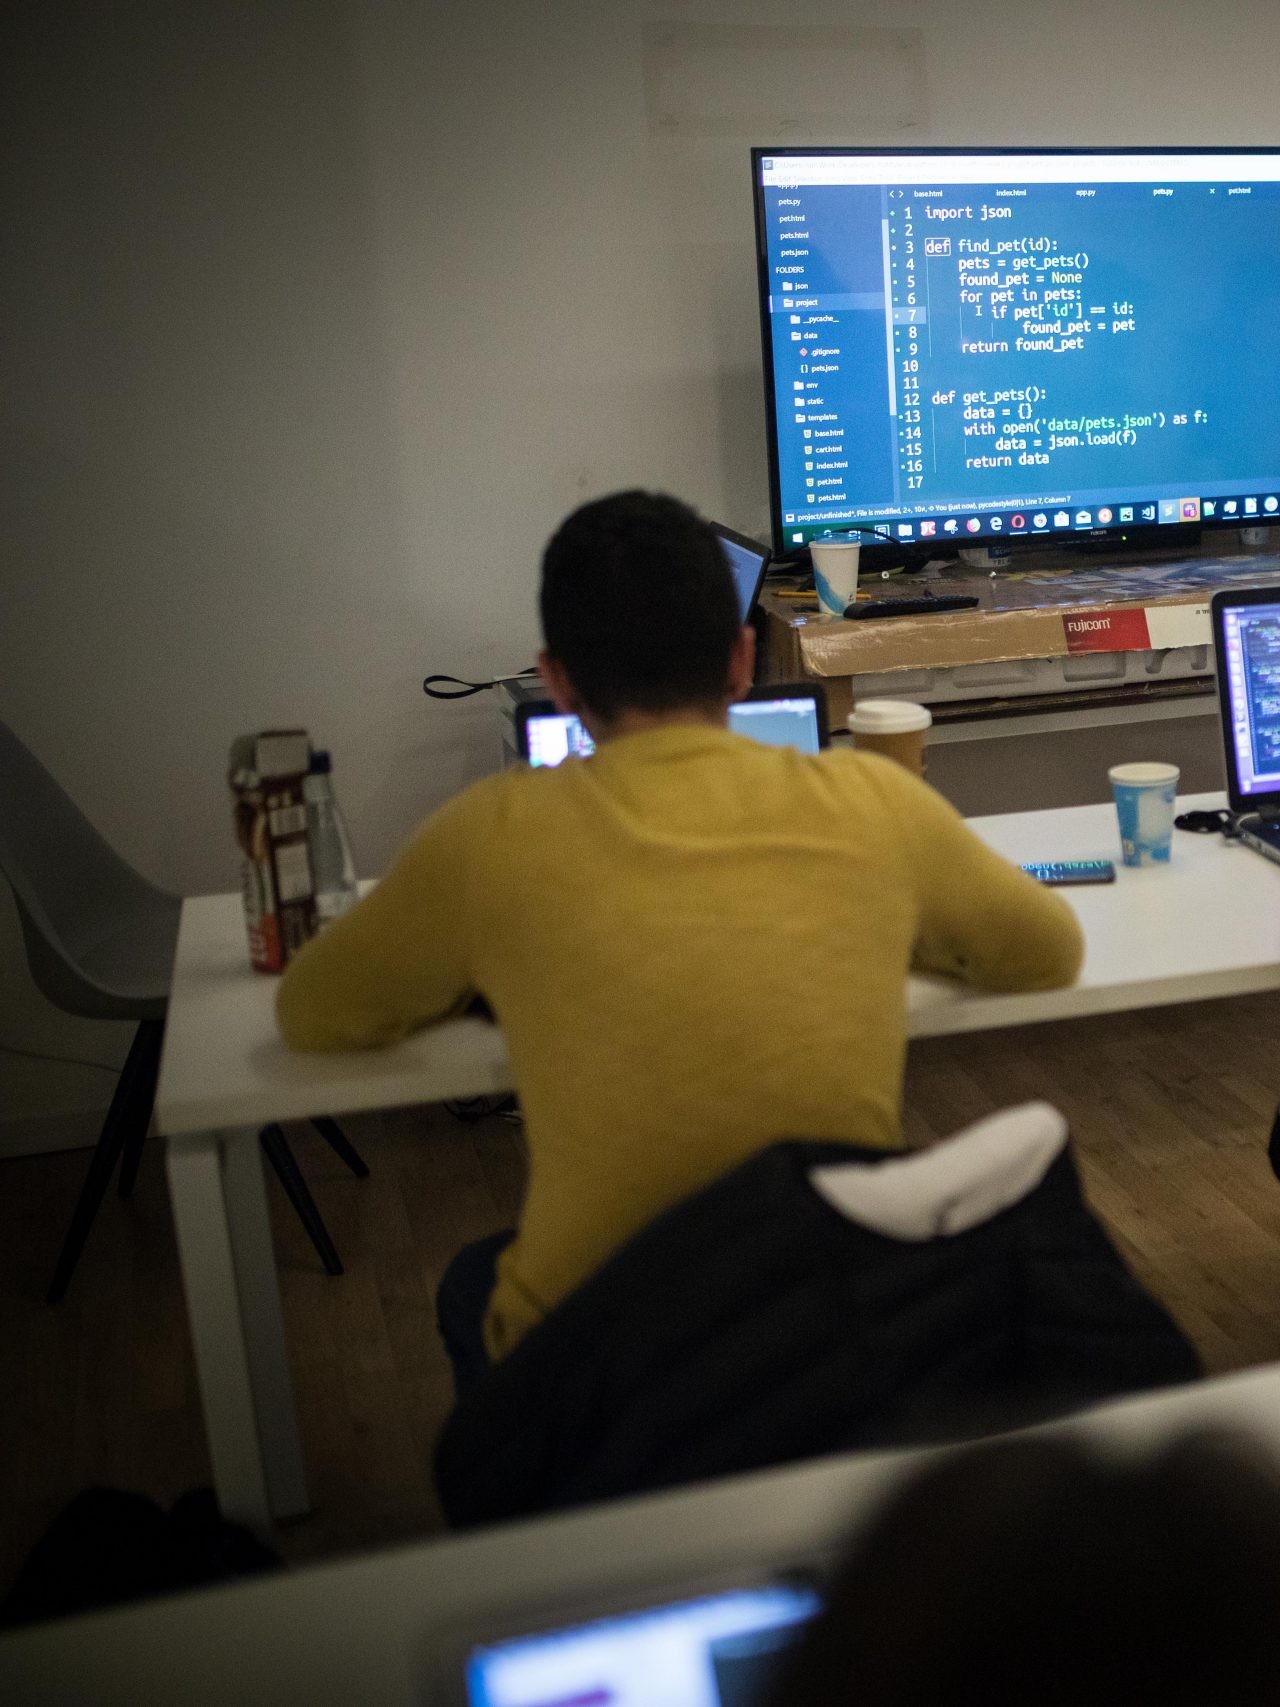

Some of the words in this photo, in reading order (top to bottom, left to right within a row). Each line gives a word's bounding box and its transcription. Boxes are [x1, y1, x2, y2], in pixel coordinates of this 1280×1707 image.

[914, 190, 943, 198] base.html
[996, 188, 1026, 197] index.html
[1076, 189, 1096, 197] app.py
[1153, 188, 1173, 197] pets.py
[1228, 187, 1251, 195] pet.html
[778, 199, 800, 207] pets.py
[779, 214, 806, 223] pet.html
[904, 207, 913, 220] 1
[925, 206, 973, 221] import
[980, 205, 1012, 220] json
[780, 231, 809, 240] pets.html
[905, 224, 913, 237] 2
[905, 241, 914, 254] 3
[926, 240, 950, 253] def
[958, 238, 1058, 254] find_pet(id):
[781, 248, 809, 257] pets.json
[906, 259, 915, 271] 4
[959, 256, 990, 272] pets
[1013, 252, 1089, 269] get_pets()
[775, 266, 804, 274] FOLDERS
[907, 276, 915, 288] 5
[959, 272, 1029, 288] found_pet
[1052, 271, 1082, 284] None
[795, 282, 809, 291] json
[908, 293, 916, 305] 6
[960, 290, 983, 303] for
[991, 290, 1014, 304] pet
[1022, 289, 1037, 302] in
[1044, 288, 1081, 303] pets:
[796, 298, 818, 308] project
[908, 310, 917, 322] 7
[992, 305, 1007, 319] if
[1014, 303, 1083, 320] pet['id']
[1114, 302, 1134, 315] id:
[909, 326, 917, 339] 8
[1023, 321, 1091, 336] found_pet
[1112, 318, 1135, 333] pet
[909, 343, 918, 356] 9
[962, 341, 1008, 354] return
[1016, 337, 1084, 352] found_pet
[903, 360, 918, 373] 10
[903, 377, 919, 389] 11
[904, 394, 920, 406] 12
[932, 391, 955, 405] def
[963, 387, 1046, 404] get_pets():
[808, 414, 838, 422] templates
[905, 411, 921, 423] 13
[964, 406, 995, 419] data
[1017, 403, 1032, 419] {}
[905, 427, 921, 439] 14
[964, 423, 995, 436] with
[1003, 413, 1165, 435] open('data/pets.json')
[1173, 414, 1187, 425] as
[1194, 410, 1207, 423] f:
[815, 429, 844, 437] base.html
[906, 443, 922, 456] 15
[996, 437, 1026, 450] data
[1048, 430, 1137, 449] json.load(f)
[816, 445, 843, 453] cart.html
[816, 461, 848, 469] index.html
[906, 460, 922, 472] 16
[966, 455, 1012, 469] return
[1018, 452, 1049, 465] data
[817, 477, 843, 486] pet.html
[907, 476, 923, 489] 17
[818, 493, 846, 503] pets.html
[857, 509, 868, 517] File
[1025, 498, 1037, 506] Line
[1044, 496, 1067, 504] Column
